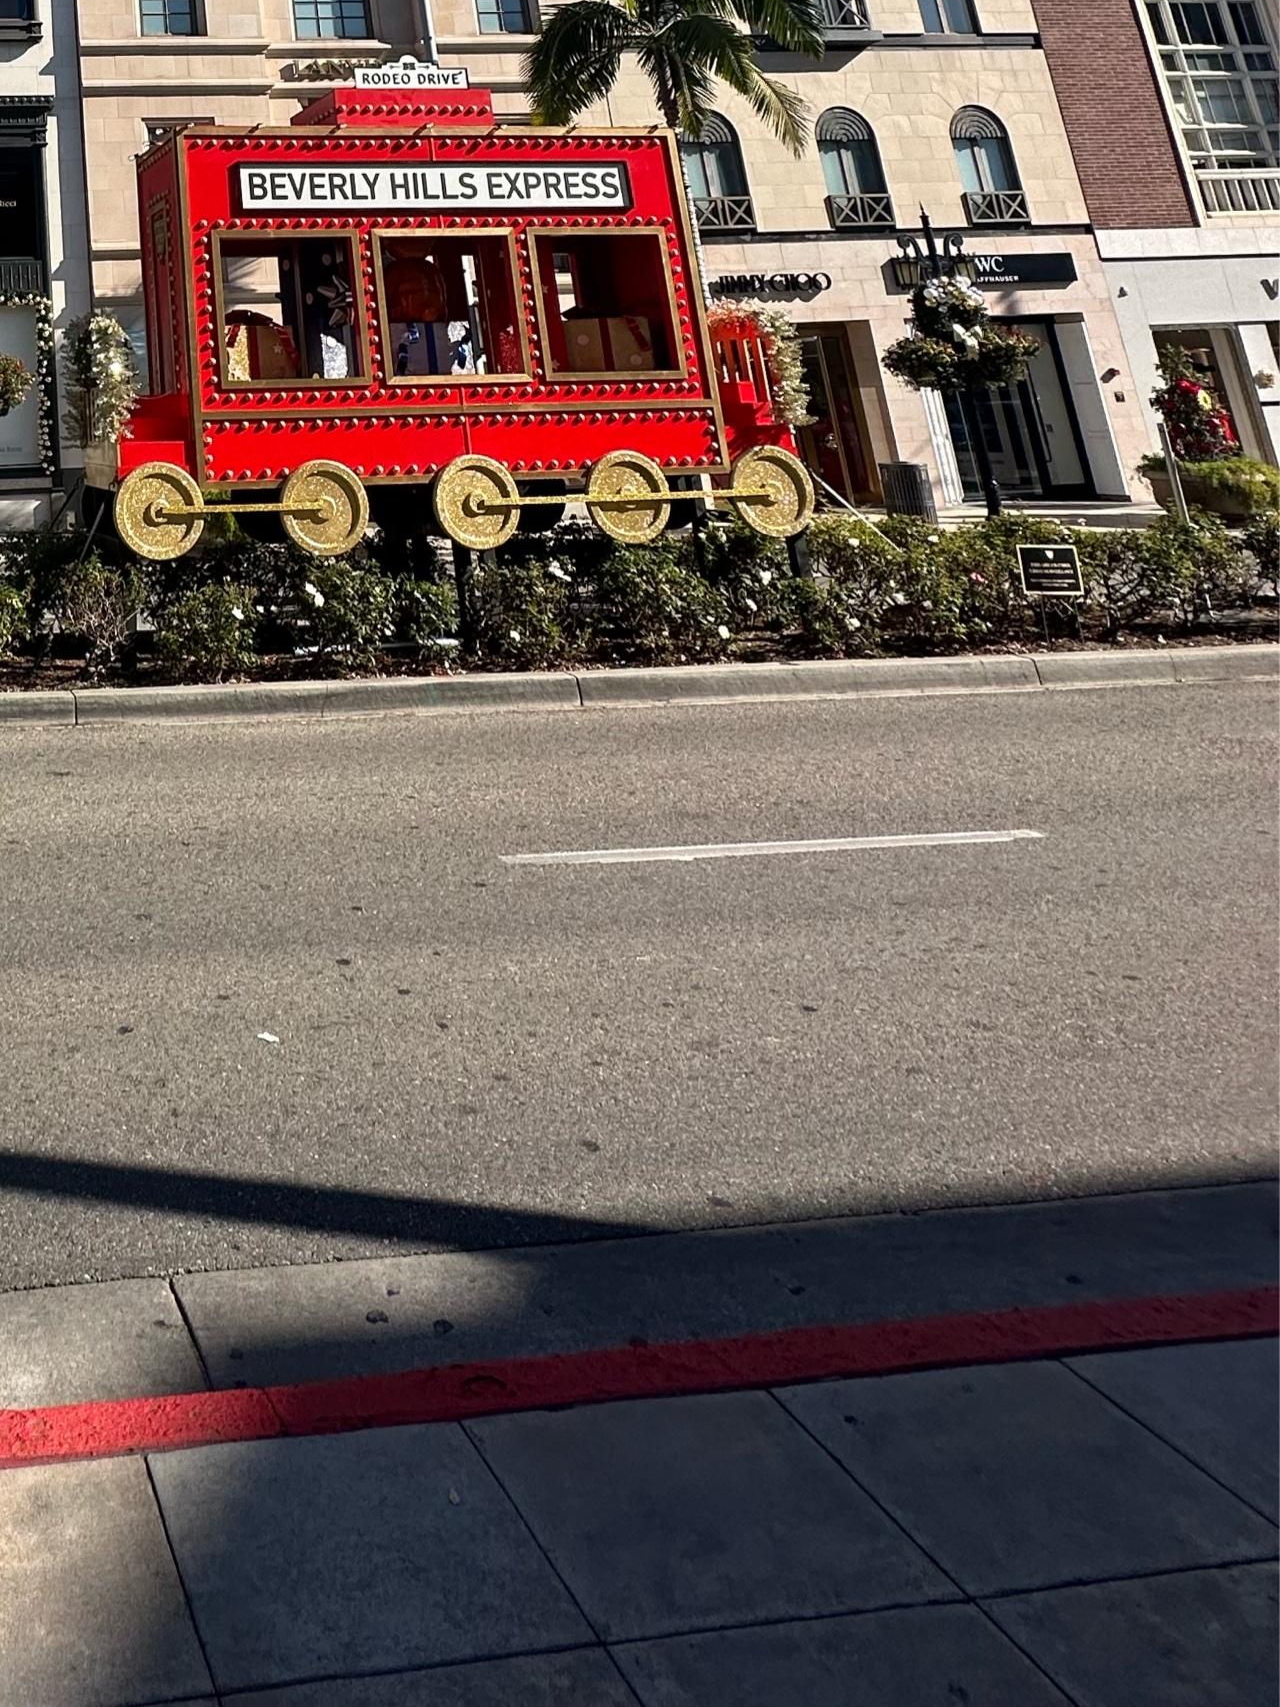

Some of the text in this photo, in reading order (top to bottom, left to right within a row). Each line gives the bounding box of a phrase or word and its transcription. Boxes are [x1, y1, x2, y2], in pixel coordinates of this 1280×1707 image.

[362, 72, 461, 85] RODEO DRIVE
[247, 171, 620, 201] BEVERLY HILLS EXPRESS
[974, 255, 1006, 273] WC
[715, 272, 832, 294] JIMMY CHOO
